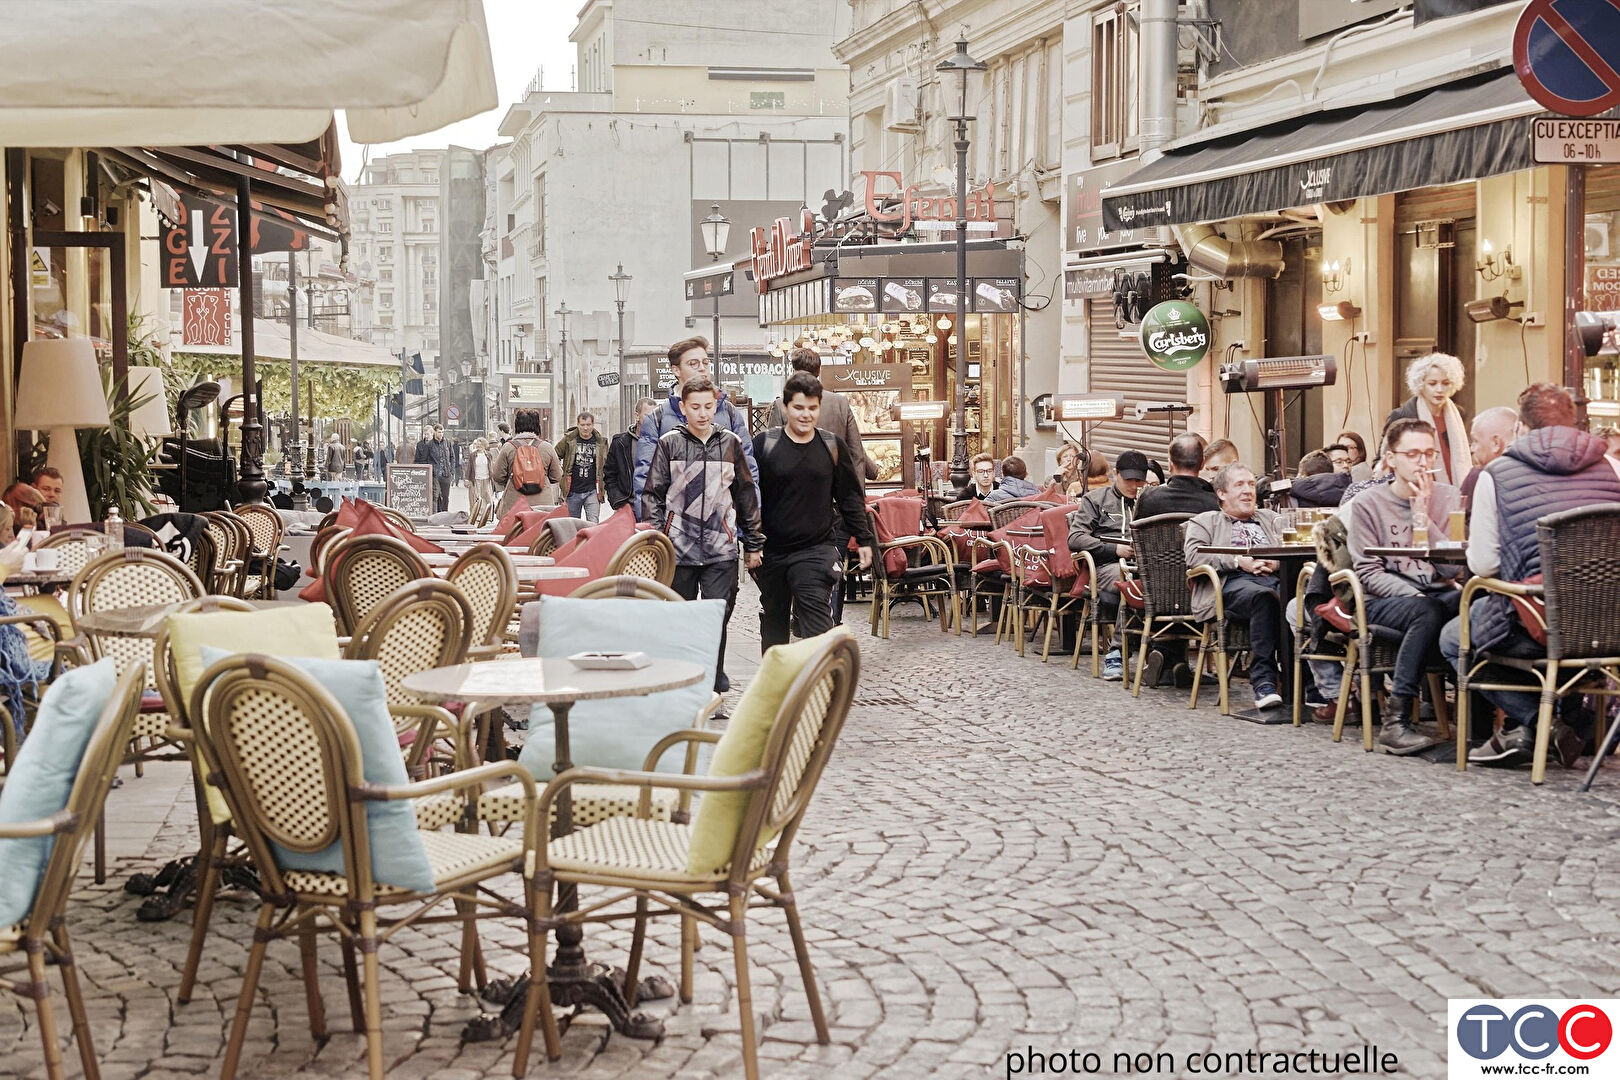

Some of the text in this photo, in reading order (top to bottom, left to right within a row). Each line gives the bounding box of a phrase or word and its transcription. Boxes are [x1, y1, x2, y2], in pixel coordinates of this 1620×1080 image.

[1537, 122, 1555, 139] CU
[223, 312, 231, 345] CLUB
[1149, 327, 1206, 356] Carlsberg
[835, 369, 891, 382] XCLUSIVE
